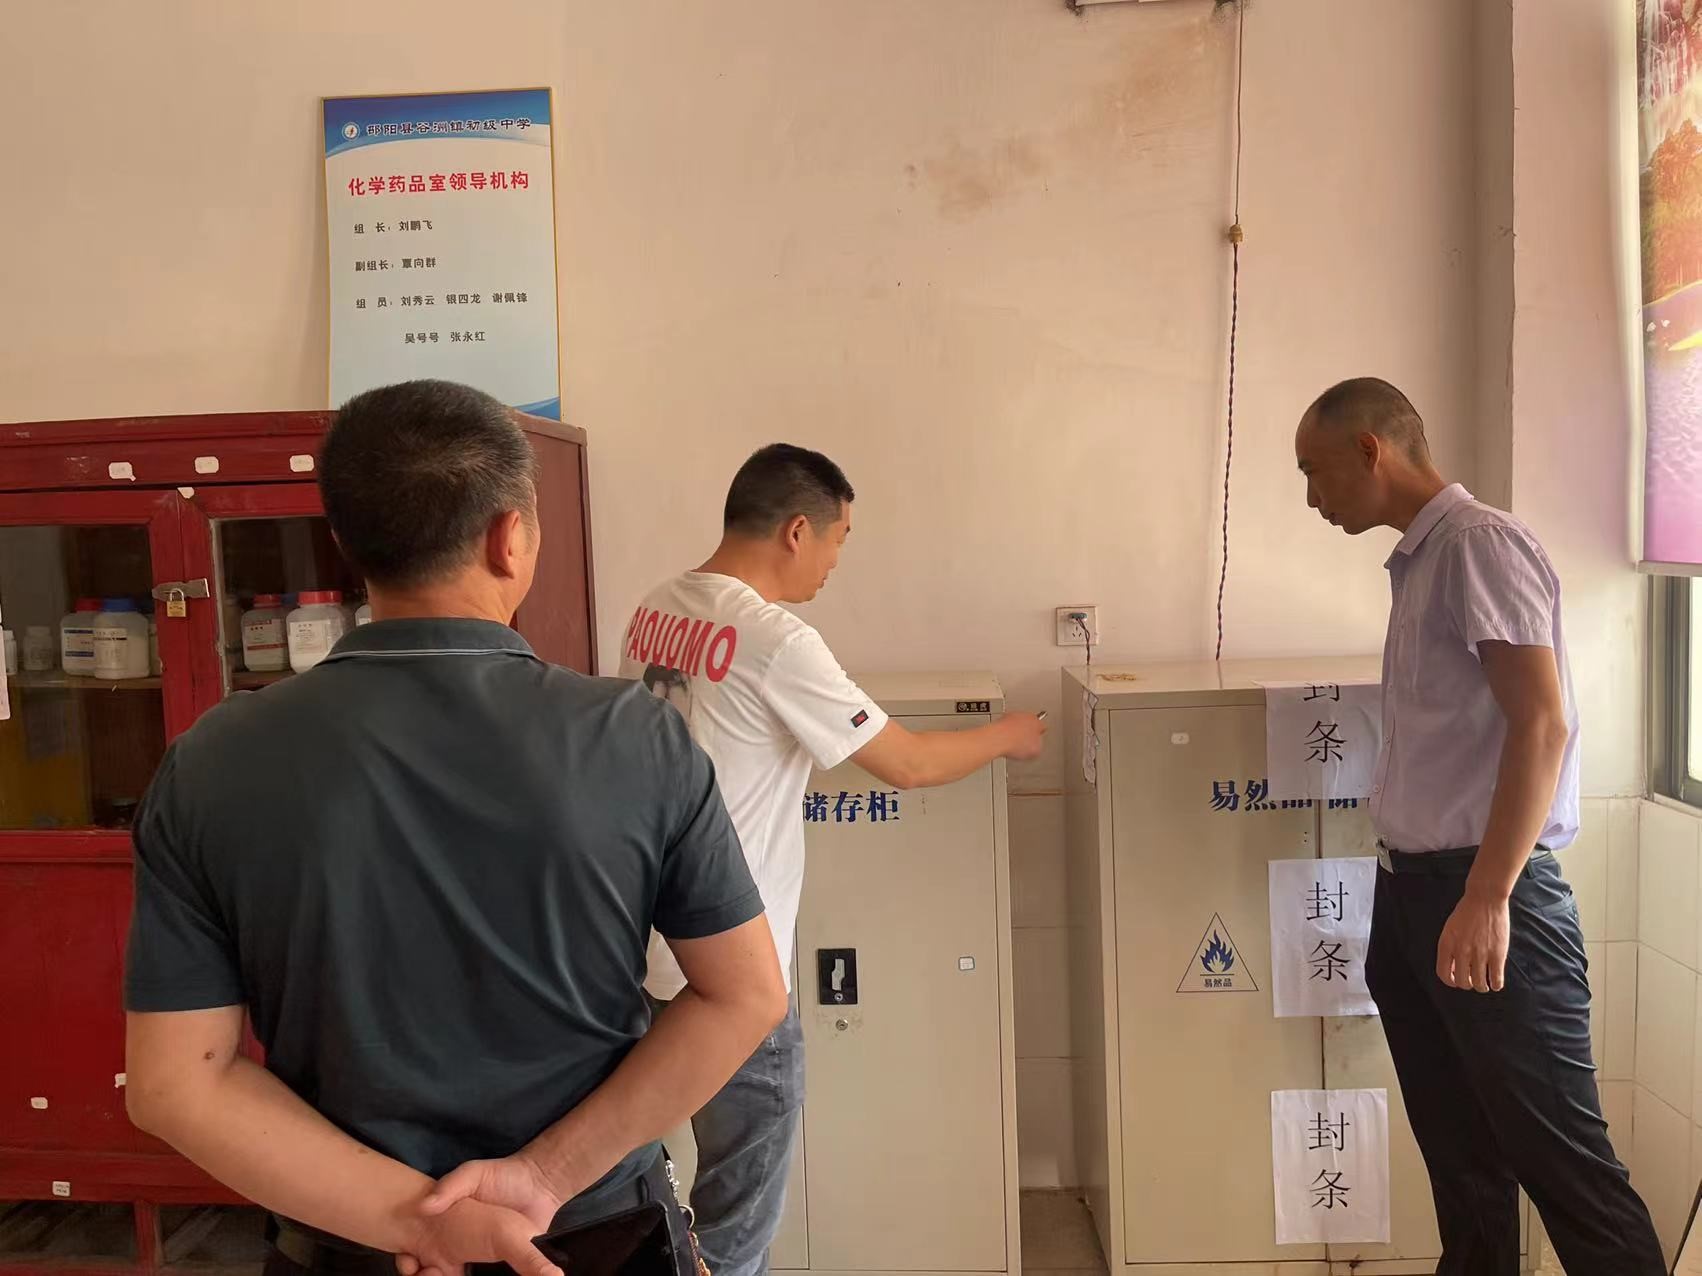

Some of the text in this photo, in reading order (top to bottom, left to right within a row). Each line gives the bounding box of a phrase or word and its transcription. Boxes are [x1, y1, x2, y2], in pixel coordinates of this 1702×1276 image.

[366, 118, 531, 136] 邵阳县谷洲镇初级中学
[348, 171, 529, 196] 化学药品室领导机构
[450, 331, 486, 343] 张永红
[1306, 881, 1350, 981] 封条
[1204, 977, 1233, 988] 易然品
[1308, 1112, 1351, 1209] 封条
